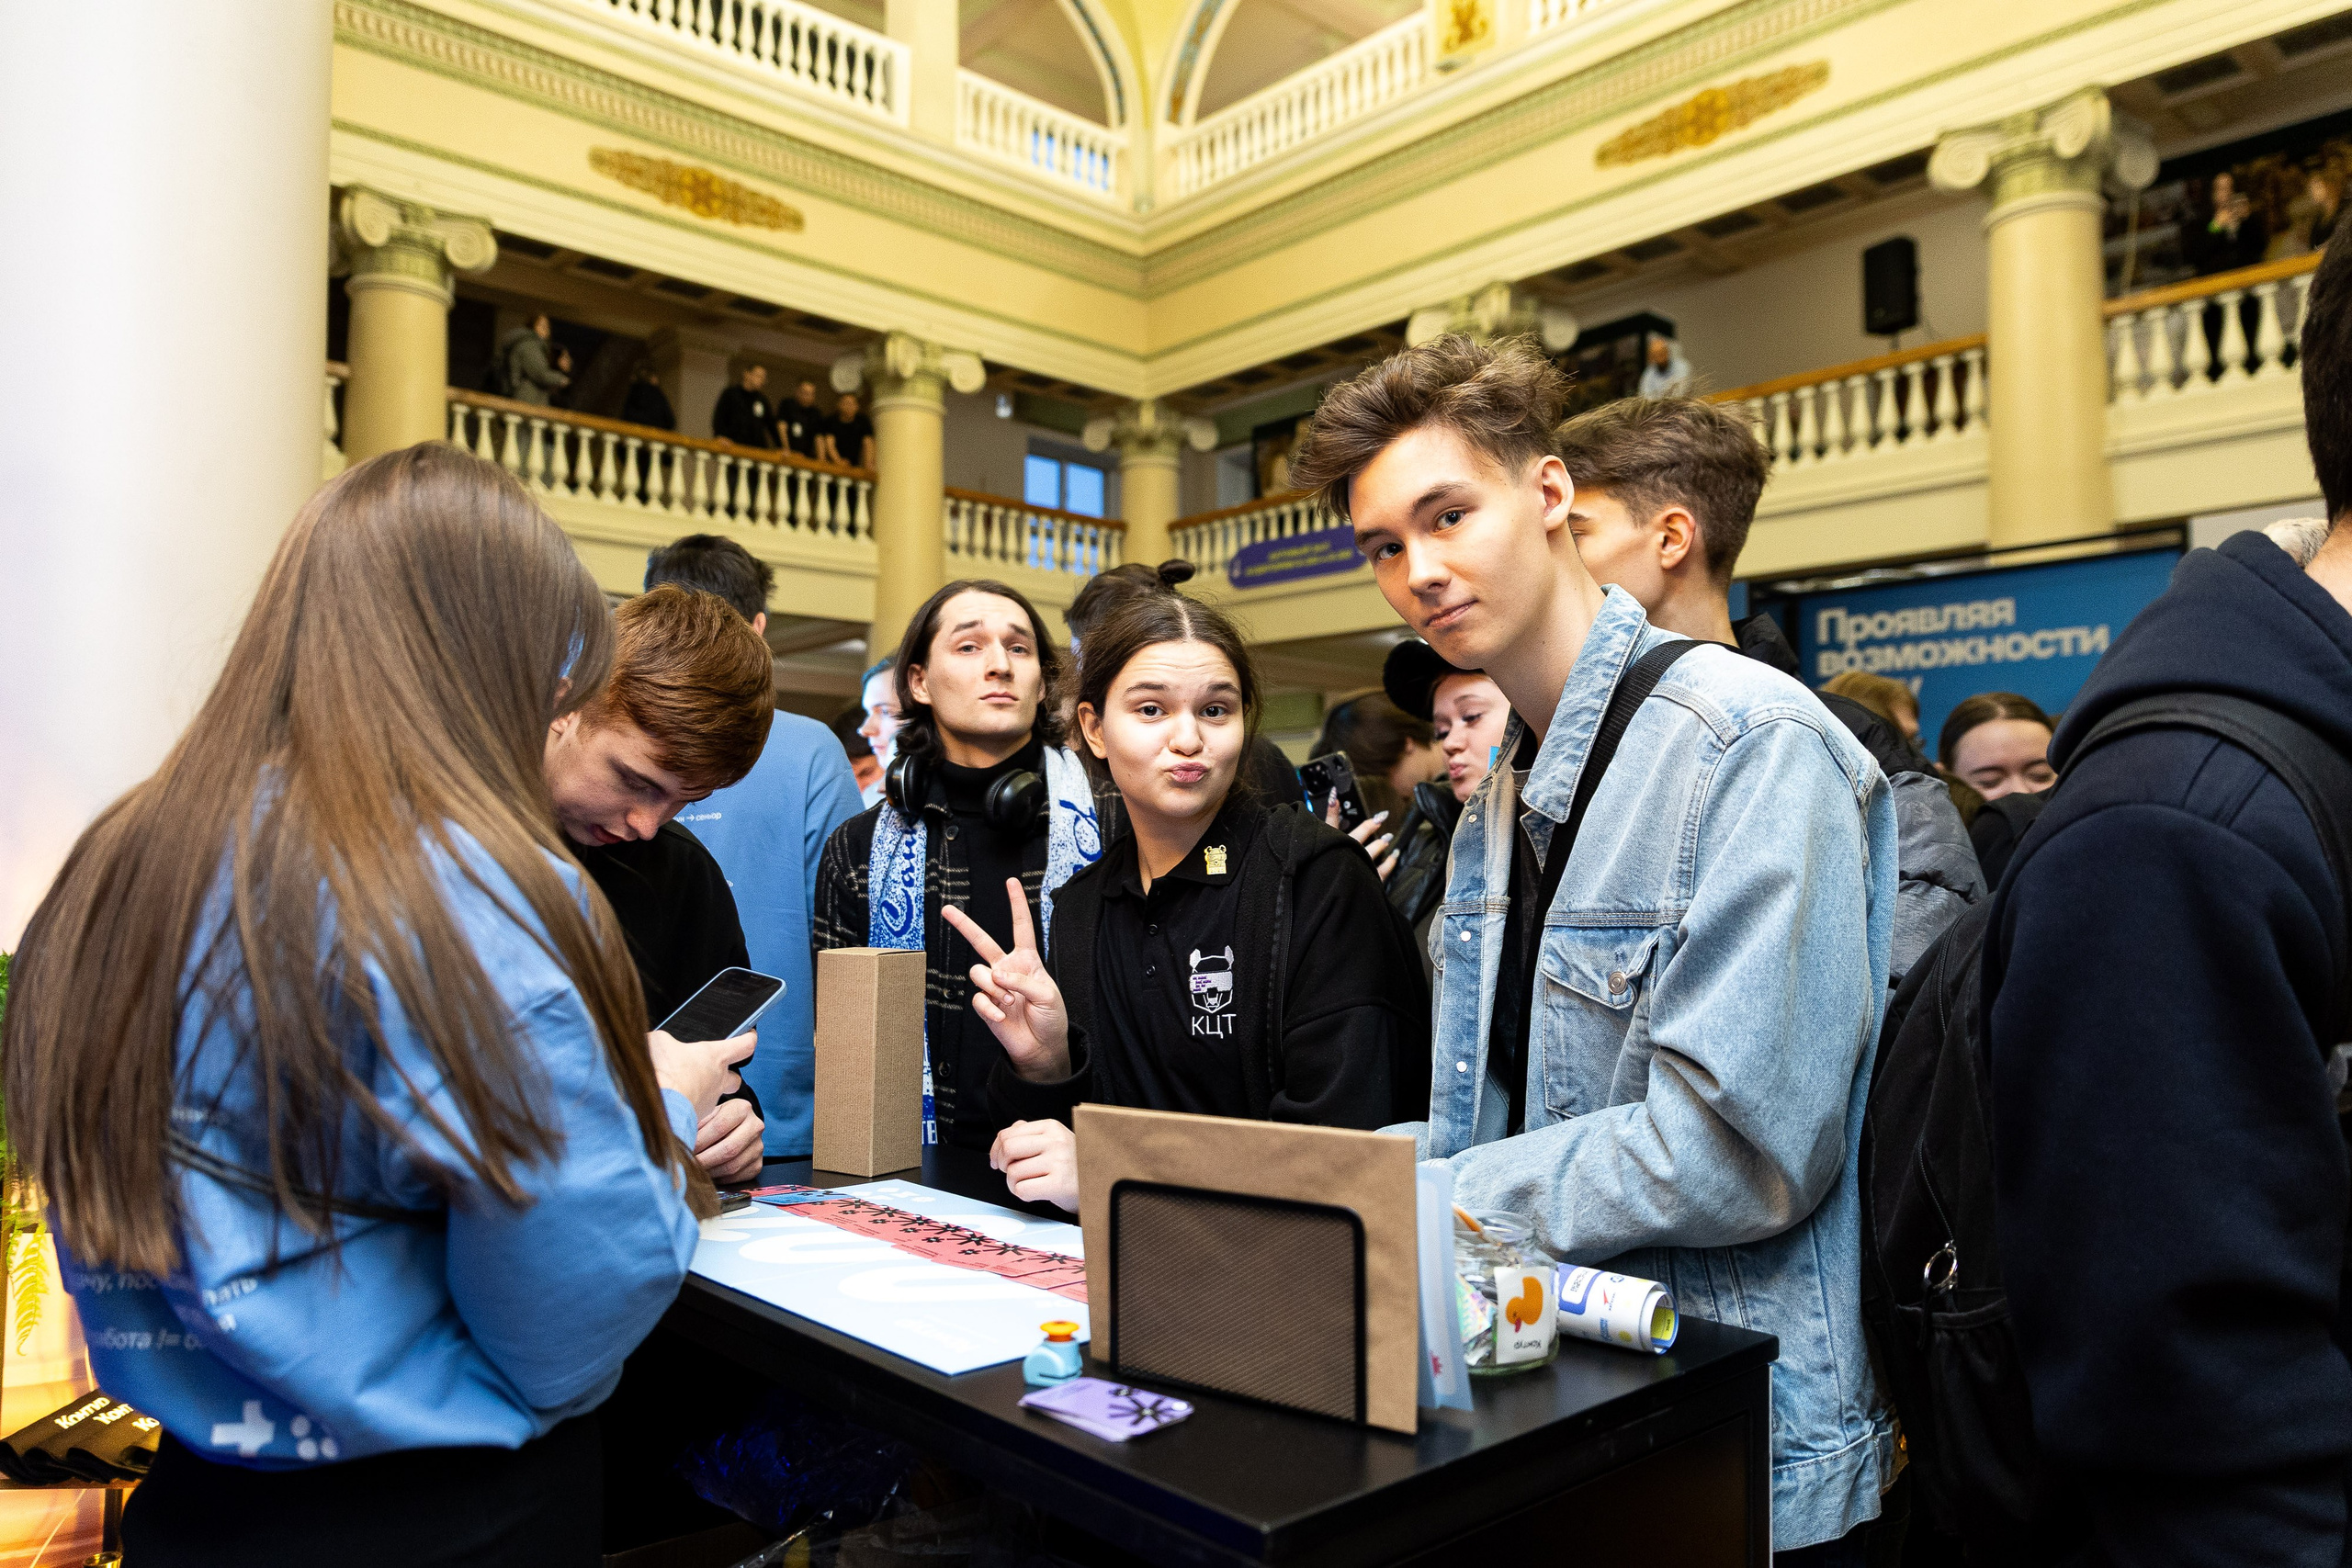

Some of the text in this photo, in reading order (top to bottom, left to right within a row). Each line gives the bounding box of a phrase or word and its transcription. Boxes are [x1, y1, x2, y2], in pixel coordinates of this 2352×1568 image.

[1816, 597, 2017, 650] Проявляя
[1815, 624, 2111, 678] возможности
[695, 812, 722, 822] сеньор
[1192, 1013, 1238, 1040] КЦТ
